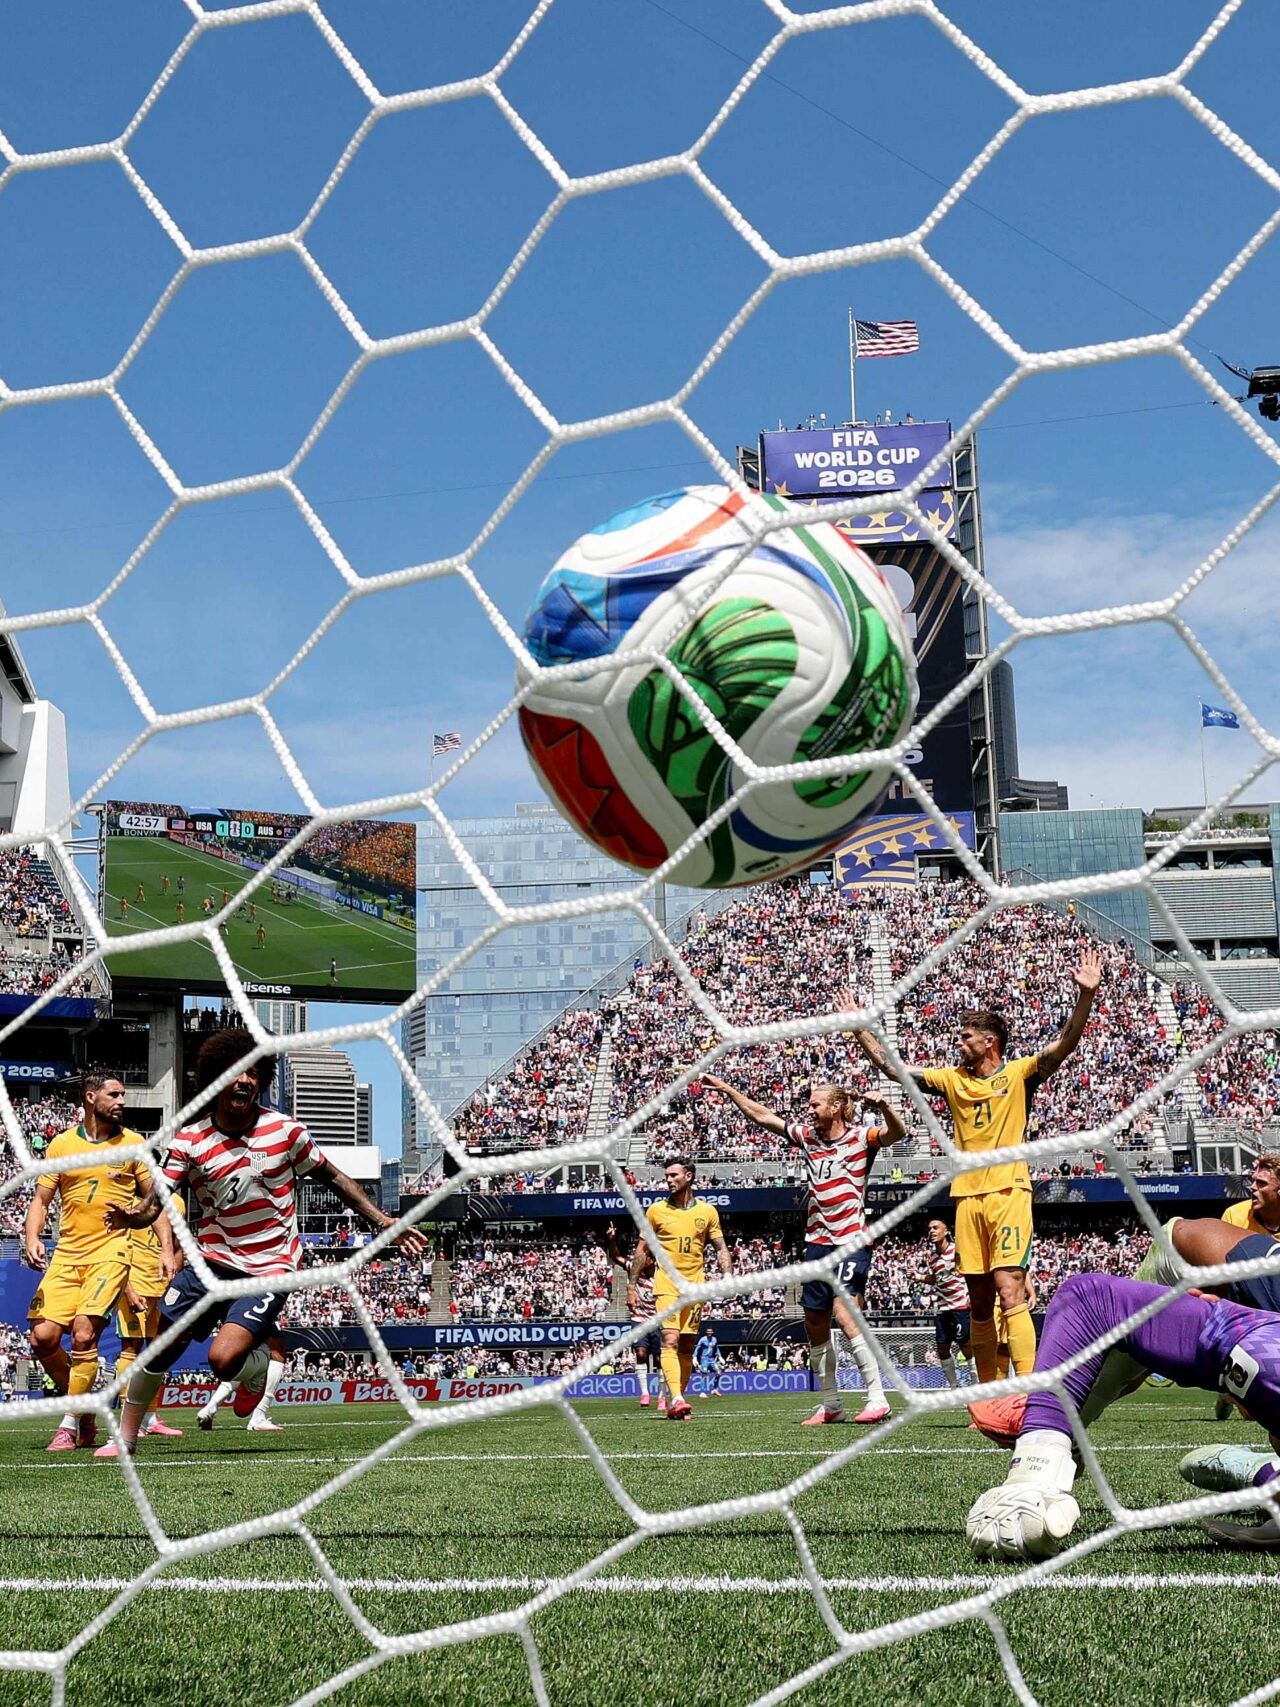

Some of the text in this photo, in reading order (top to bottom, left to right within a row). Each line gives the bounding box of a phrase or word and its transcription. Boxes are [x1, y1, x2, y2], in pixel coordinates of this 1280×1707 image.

[832, 430, 879, 448] FIFA
[794, 447, 920, 469] WORLD CUP
[818, 469, 896, 488] 2026
[126, 816, 159, 829] 42:57
[195, 822, 274, 836] USA 1 0 AUS
[361, 902, 378, 917] VISA
[53, 925, 83, 936] 344
[239, 981, 291, 994] Hisense
[8, 1065, 55, 1078] 2026
[973, 1100, 992, 1129] 21
[251, 1152, 266, 1161] USA
[818, 1160, 834, 1179] 13
[86, 1179, 99, 1204] 7
[227, 1177, 240, 1204] 3
[867, 1188, 914, 1202] SEATT
[573, 1198, 603, 1210] FIFA
[603, 1197, 652, 1209] WOLD
[695, 1194, 731, 1206] 026
[678, 1236, 692, 1254] 13
[1001, 1225, 1021, 1251] 21
[837, 1261, 857, 1281] 13
[93, 1277, 107, 1301] 7
[252, 1291, 275, 1314] 3
[435, 1325, 633, 1343] FIFA WORLD CUP 202
[956, 1323, 963, 1336] 2
[450, 1380, 523, 1399] Betano
[686, 1372, 808, 1392] aken.com
[161, 1387, 237, 1405] Betao
[275, 1384, 333, 1403] etano
[353, 1383, 428, 1401] Betao
